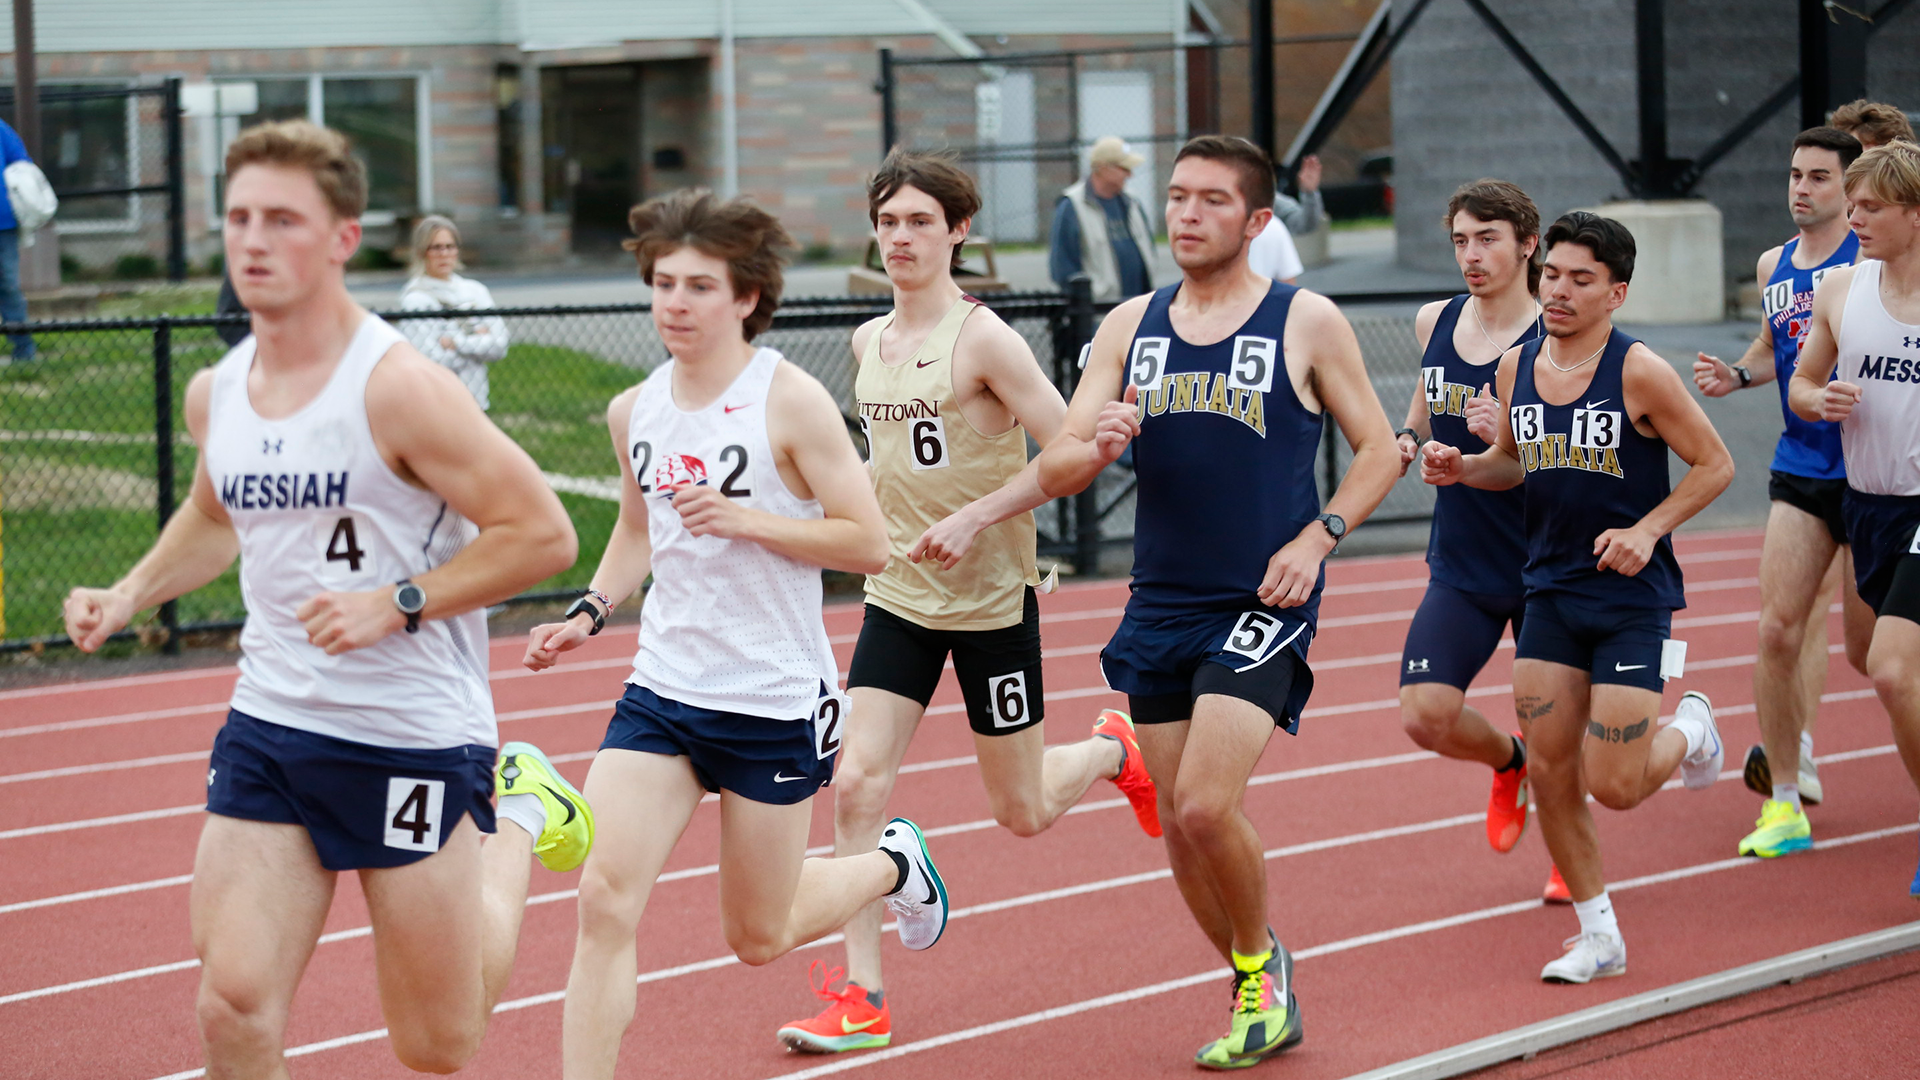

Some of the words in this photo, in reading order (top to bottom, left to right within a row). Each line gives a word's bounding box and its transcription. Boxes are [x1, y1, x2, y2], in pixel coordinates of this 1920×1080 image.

[1766, 282, 1789, 315] 10
[1773, 301, 1813, 329] PHILADE
[1793, 290, 1814, 305] REAT
[1133, 341, 1161, 386] 5
[1235, 340, 1267, 386] 5
[858, 398, 942, 422] UTZTOWN
[1513, 407, 1538, 441] 13
[1577, 411, 1613, 447] 13
[913, 421, 942, 466] 6
[633, 441, 652, 493] 2
[719, 445, 751, 498] 2
[222, 471, 349, 510] MESSIAH
[326, 516, 365, 572] 4
[1231, 611, 1274, 652] 5
[996, 677, 1024, 722] 6
[818, 698, 840, 755] 2
[1605, 726, 1621, 743] 13
[392, 783, 432, 844] 4
